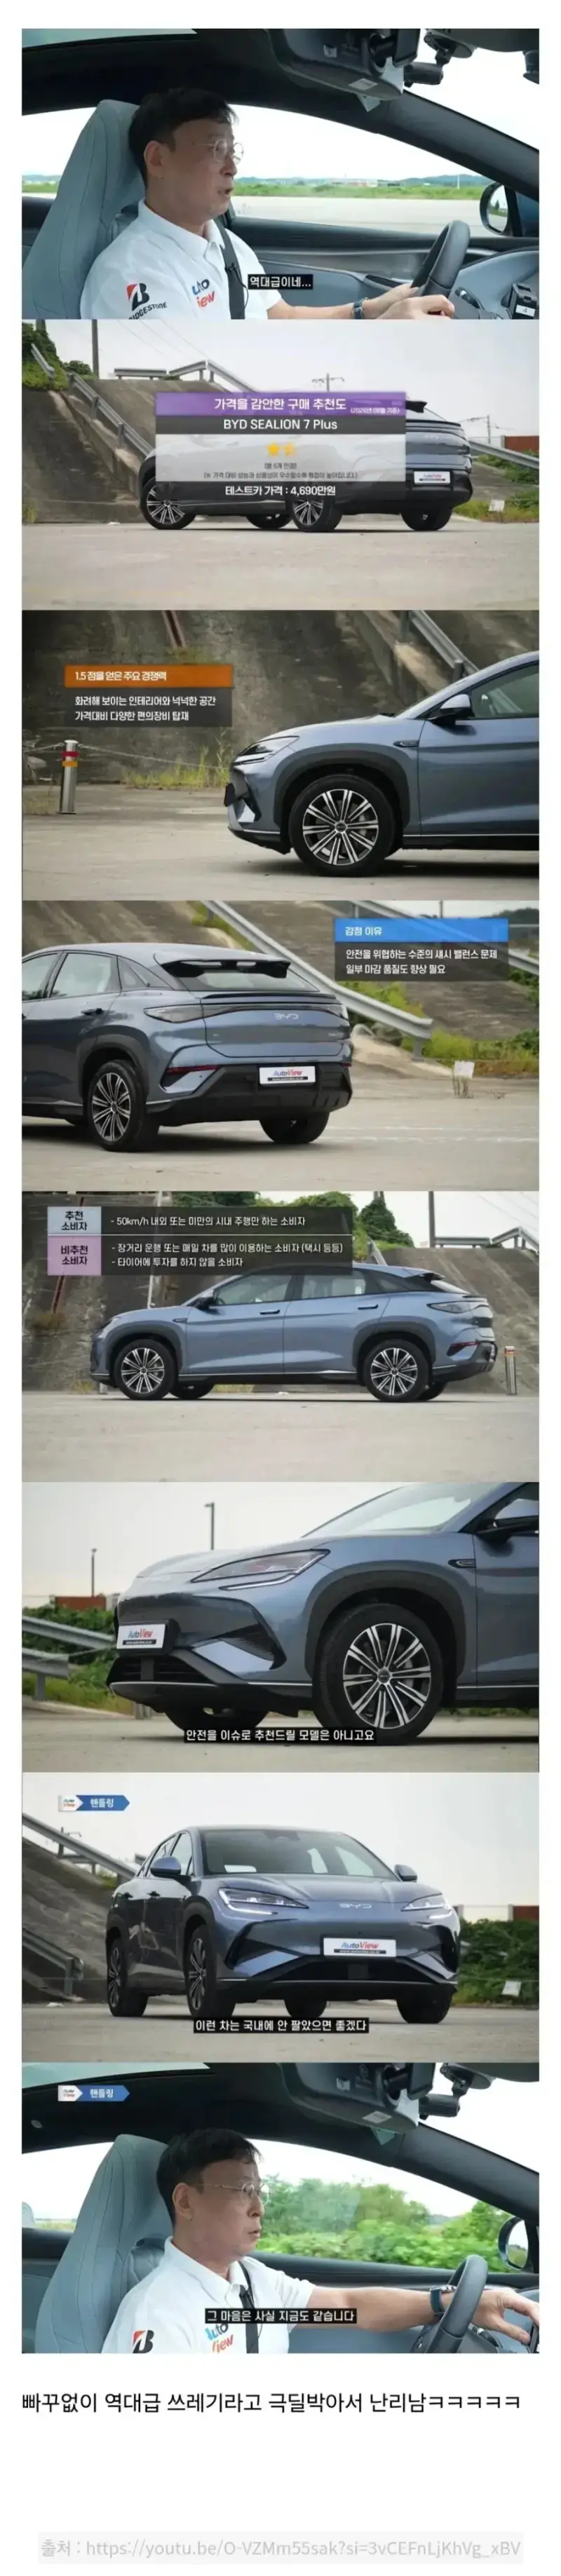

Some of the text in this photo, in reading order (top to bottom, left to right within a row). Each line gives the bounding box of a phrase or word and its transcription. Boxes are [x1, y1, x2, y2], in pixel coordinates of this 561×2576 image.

[191, 279, 210, 295] uto
[196, 291, 215, 308] iew
[128, 302, 168, 320] IDGESTONE
